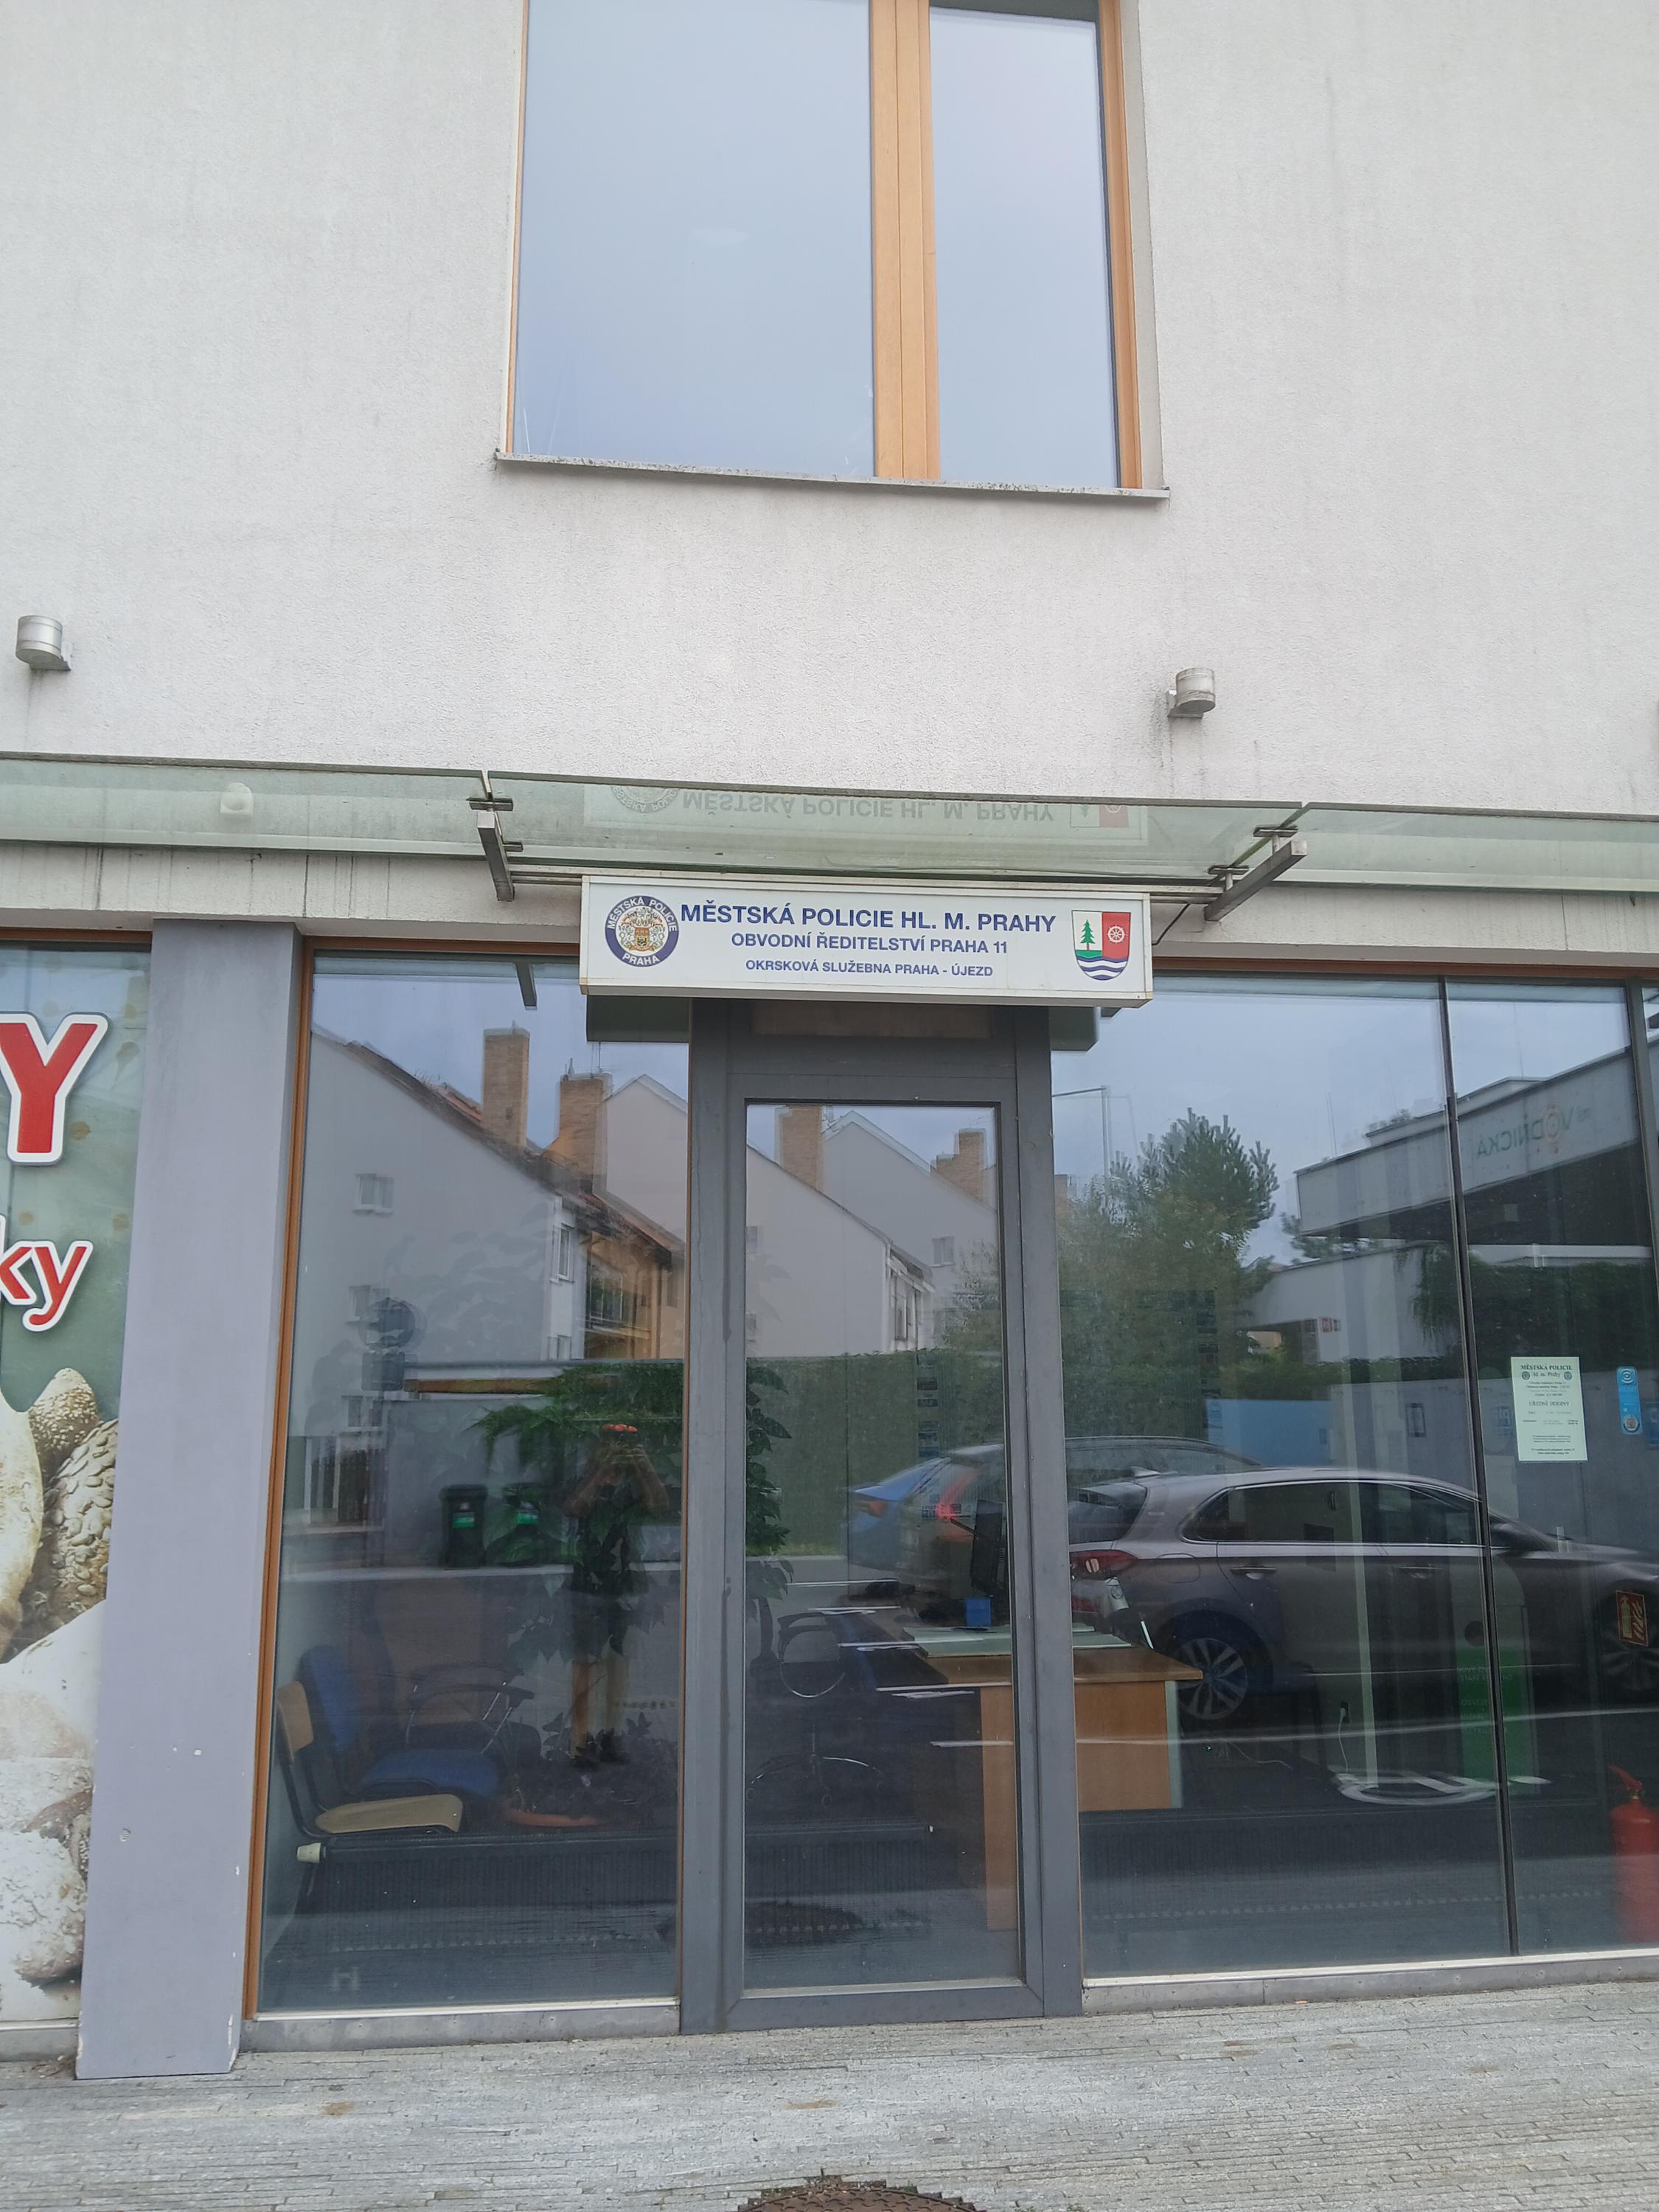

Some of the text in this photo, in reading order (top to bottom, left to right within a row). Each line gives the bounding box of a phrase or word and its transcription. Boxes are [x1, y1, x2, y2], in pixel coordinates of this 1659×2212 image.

[649, 899, 678, 933] POLICIE
[681, 900, 1057, 933] MĚSTSKÁ POLICIE HL. M. PRAHY
[731, 932, 1007, 953] OBVODNÍ ŘEDITELSTVÍ PRAHA 11
[622, 953, 660, 966] PRAHA
[745, 959, 819, 972] OKRSKOVÁ
[821, 961, 891, 974] SLUŽEBNA
[894, 964, 939, 975] PRAHA
[951, 963, 993, 976] ÚJEZD
